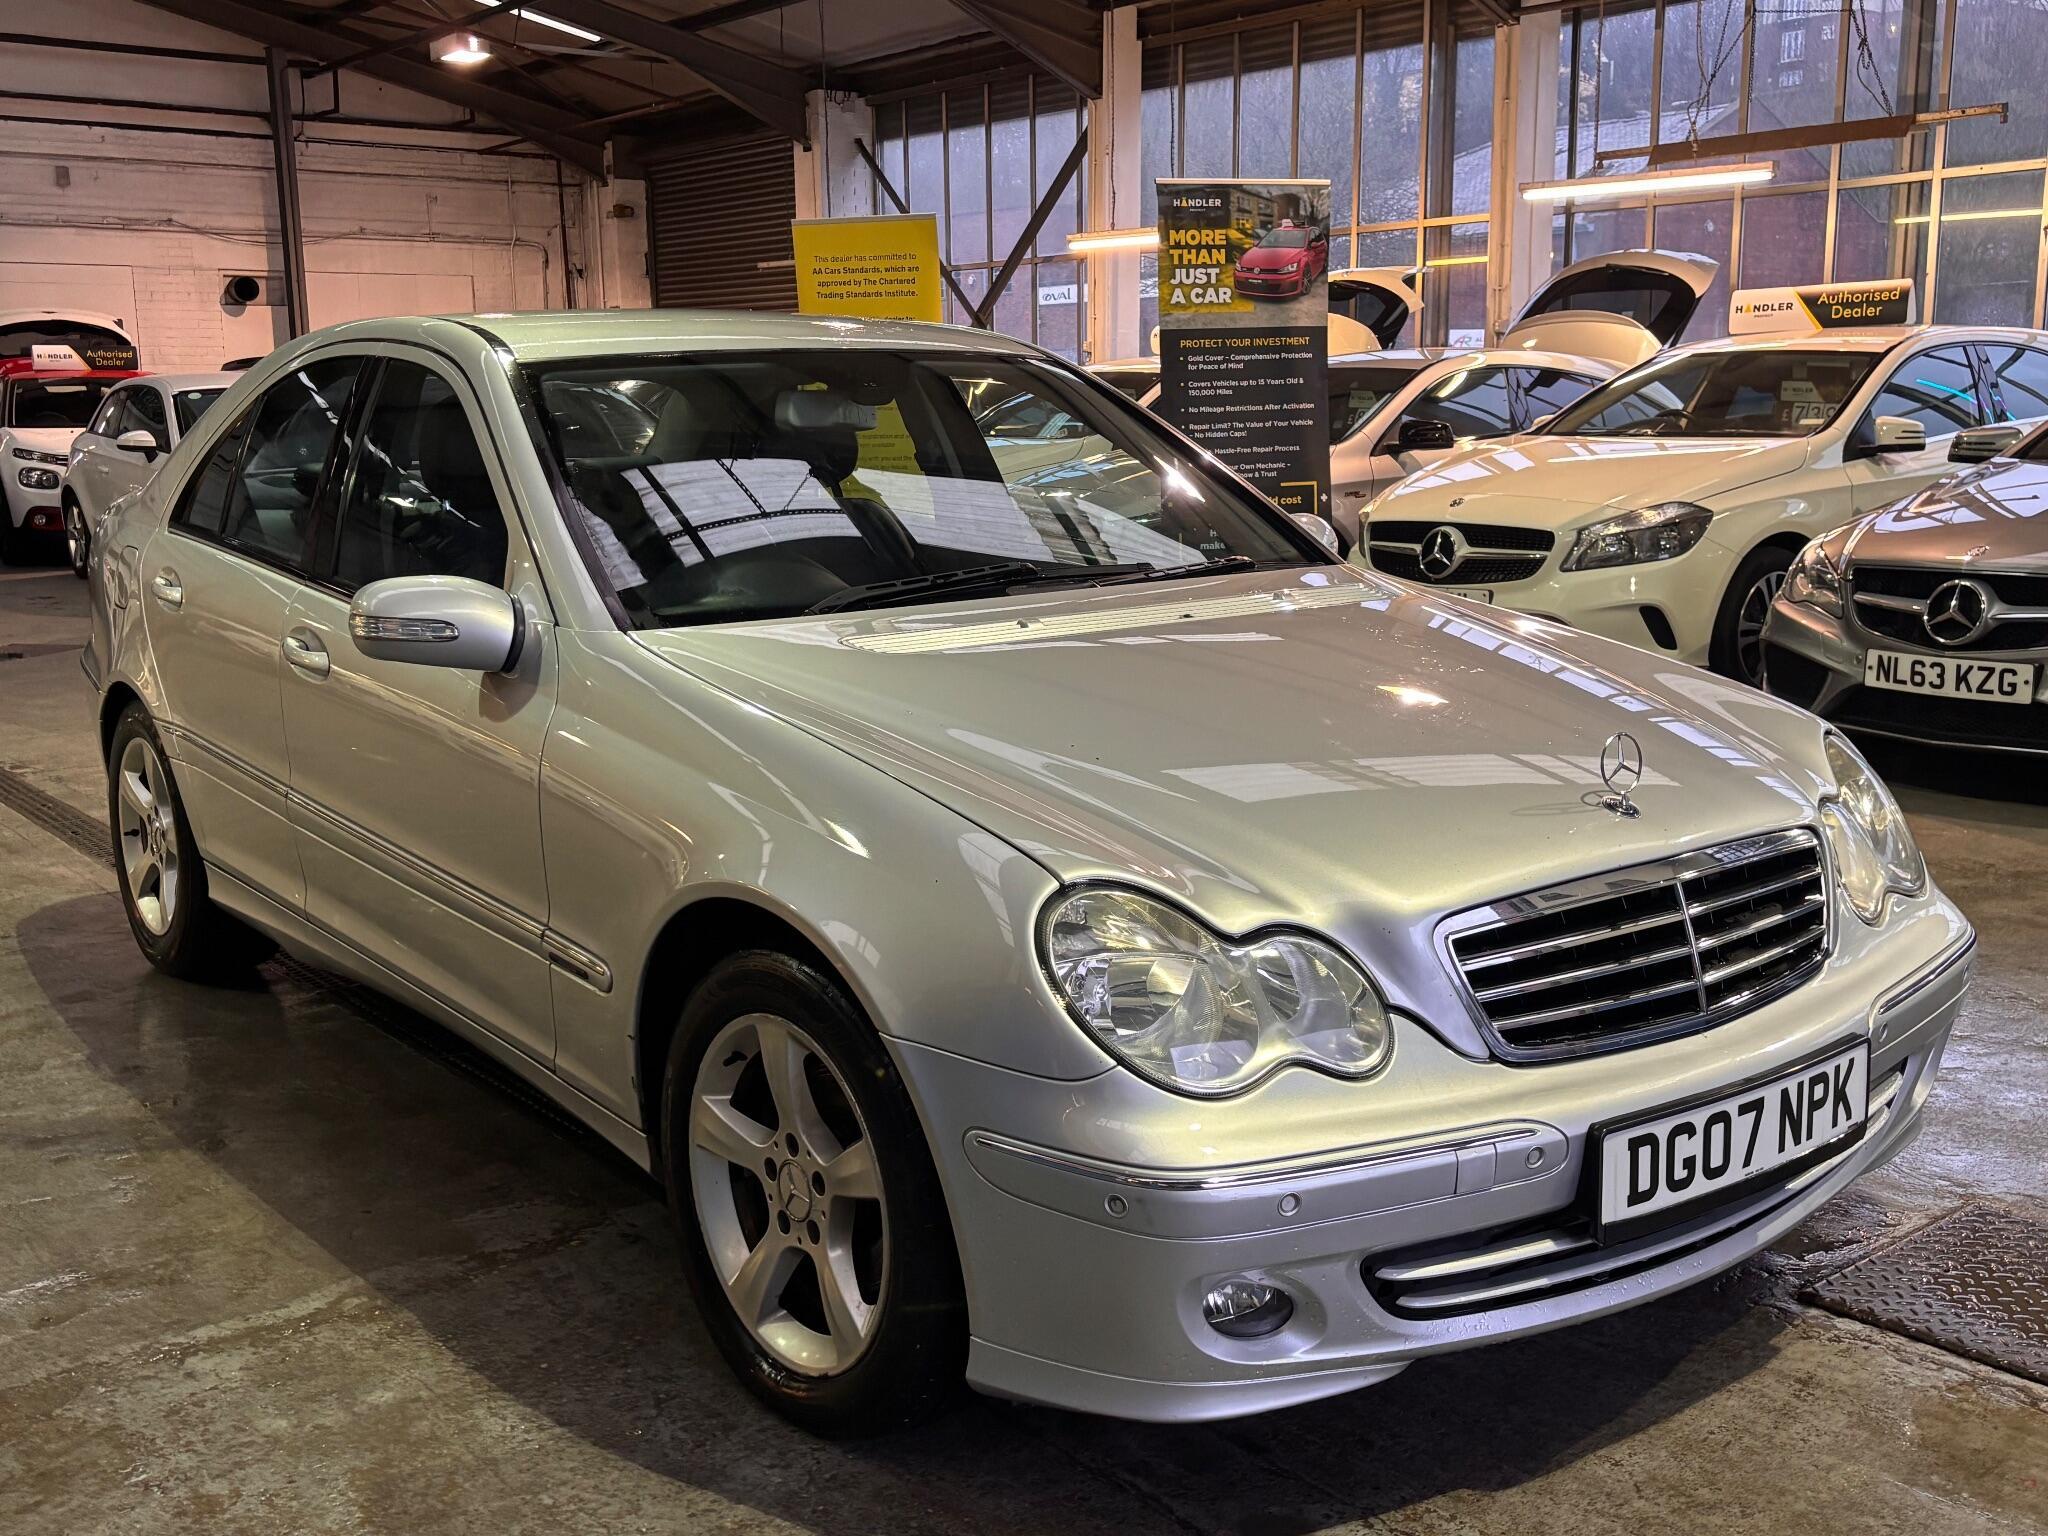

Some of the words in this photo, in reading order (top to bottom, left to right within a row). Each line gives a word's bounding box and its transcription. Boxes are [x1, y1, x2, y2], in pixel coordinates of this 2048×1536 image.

[1169, 229, 1227, 245] MORE
[854, 254, 867, 262] has
[868, 253, 907, 261] committed
[1170, 249, 1225, 265] THAN
[824, 267, 841, 275] Cars
[843, 266, 882, 274] Standards,
[1170, 268, 1219, 284] JUST
[817, 279, 851, 287] approved
[853, 279, 862, 287] by
[879, 277, 915, 285] Chartered
[817, 291, 844, 300] Trading
[846, 290, 883, 298] Standards
[885, 289, 918, 297] Institute.
[1170, 288, 1186, 304] A
[1190, 288, 1232, 304] CAR
[1817, 287, 1901, 305] Authorised
[1831, 303, 1883, 319] Dealer
[1180, 339, 1222, 348] PROTECT
[1226, 338, 1251, 347] YOUR
[1253, 337, 1310, 346] INVESTMENT
[87, 350, 133, 358] Authorised
[1230, 353, 1279, 361] Comprehensive
[96, 358, 124, 366] Dealer
[1200, 405, 1224, 413] Mileage
[1226, 404, 1263, 412] Restrictions
[1189, 423, 1210, 431] Repair
[1229, 430, 1247, 438] Caps!
[1215, 446, 1251, 455] Hassle-Free
[1253, 446, 1274, 454] Repair
[1281, 495, 1301, 504] cost
[1876, 654, 1945, 690] NL63
[1955, 664, 2018, 696] KZG
[1627, 1096, 1765, 1208] DG07
[1778, 1057, 1855, 1154] NPK
